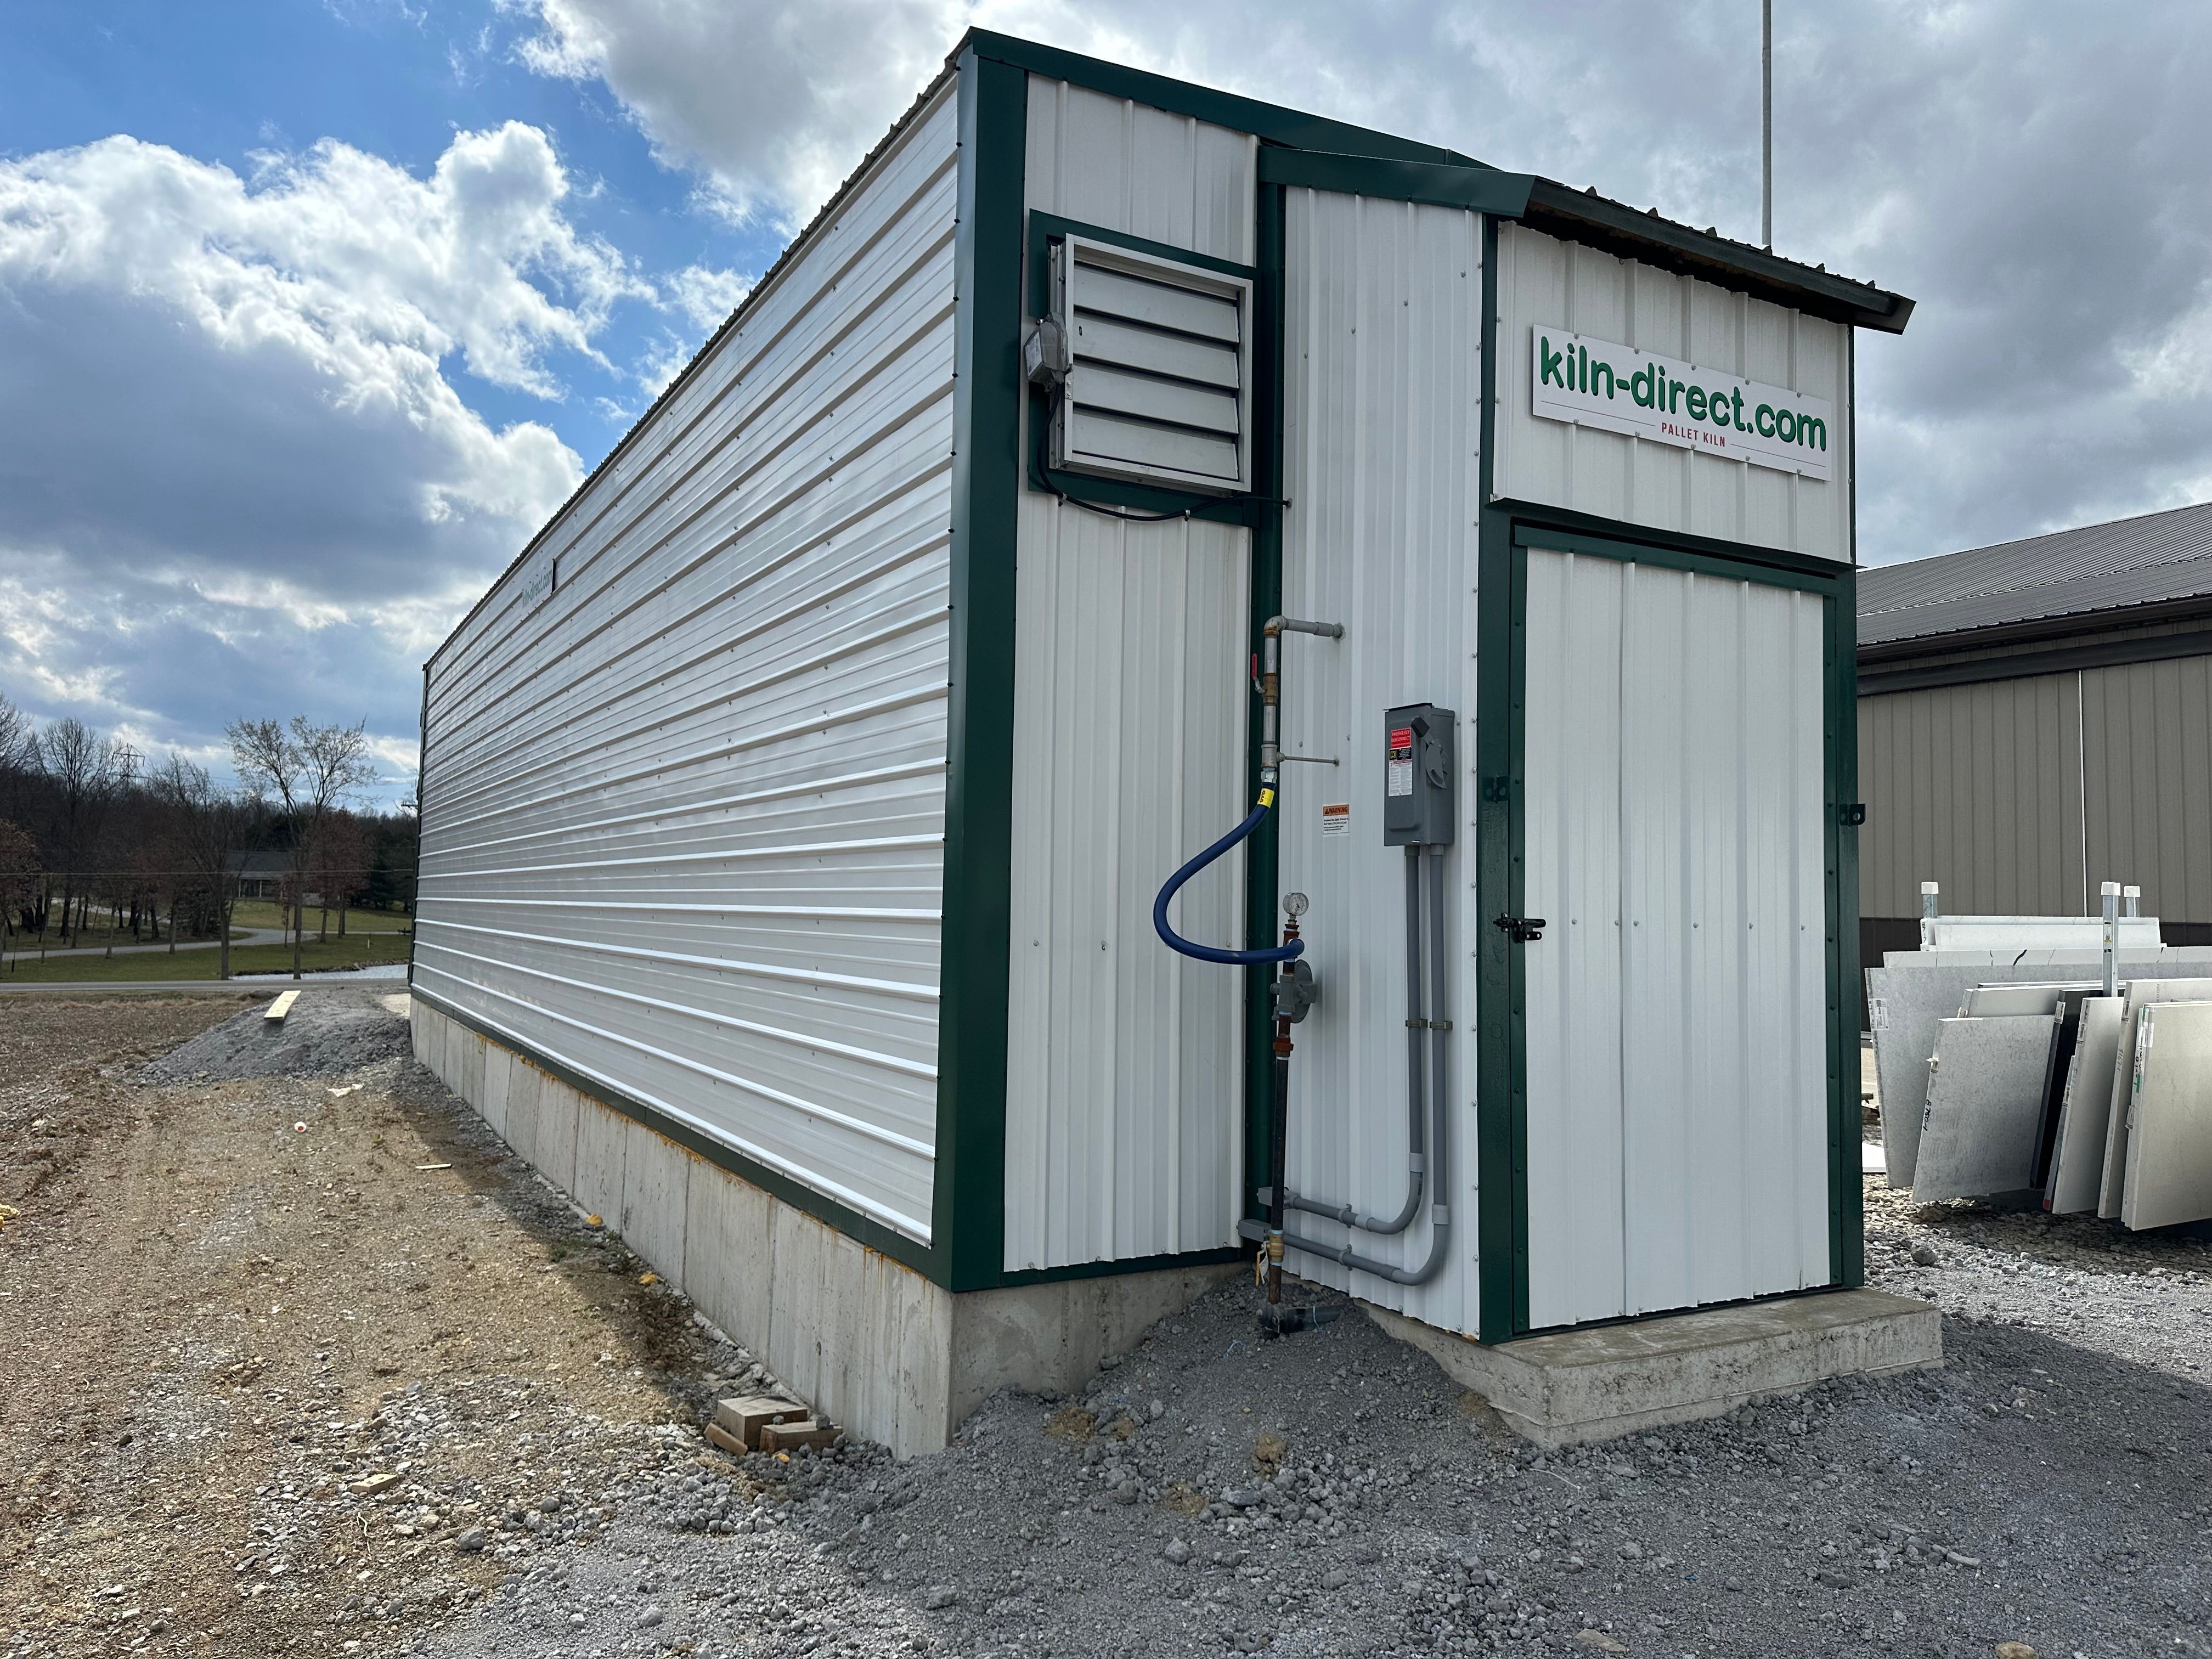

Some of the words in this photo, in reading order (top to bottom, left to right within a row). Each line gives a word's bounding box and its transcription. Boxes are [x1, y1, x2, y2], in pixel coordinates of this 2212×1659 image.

[1540, 336, 1826, 452] kiln-direct.com
[1662, 422, 1699, 441] PALLET
[1703, 432, 1725, 448] KILN
[1922, 1099, 1932, 1131] 8750-1
